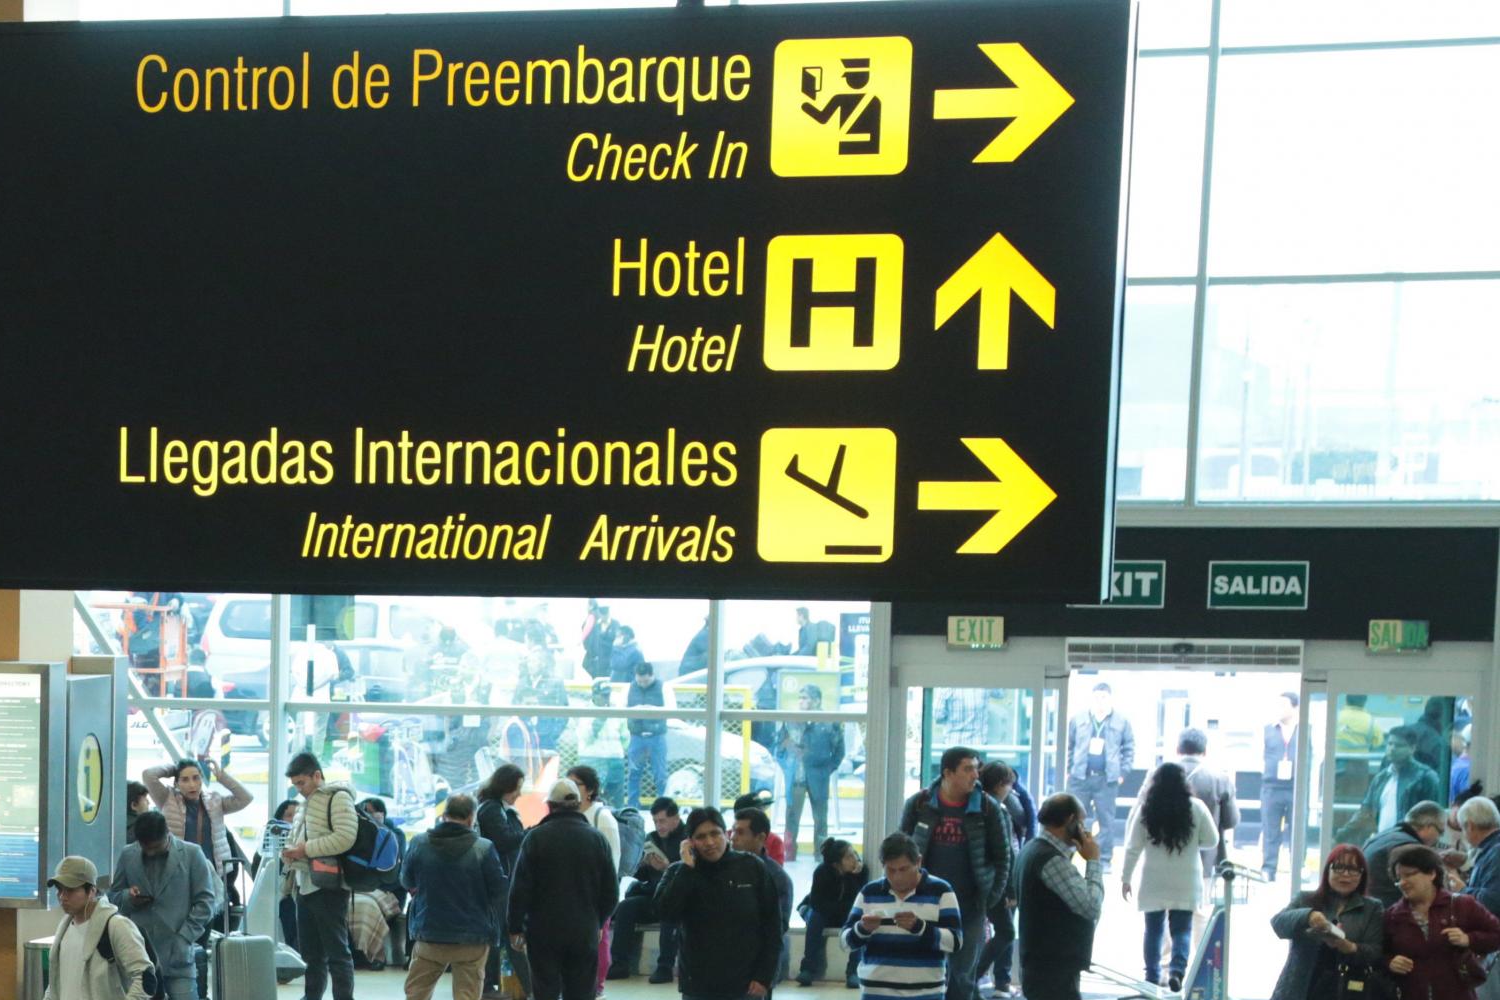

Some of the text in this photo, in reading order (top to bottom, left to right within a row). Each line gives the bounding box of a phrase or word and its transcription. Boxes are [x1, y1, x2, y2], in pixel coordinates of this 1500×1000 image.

[137, 45, 751, 115] Control de Preembarque
[567, 130, 749, 182] Check In
[613, 237, 745, 298] Hotel
[628, 324, 742, 373] Hotel
[119, 427, 738, 497] Llegadas Internacionales
[302, 512, 736, 563] International Arrivals
[1112, 572, 1159, 597] XIT
[1214, 576, 1302, 596] SALIDA
[956, 618, 995, 642] EXIT
[1370, 622, 1427, 646] SALIDA
